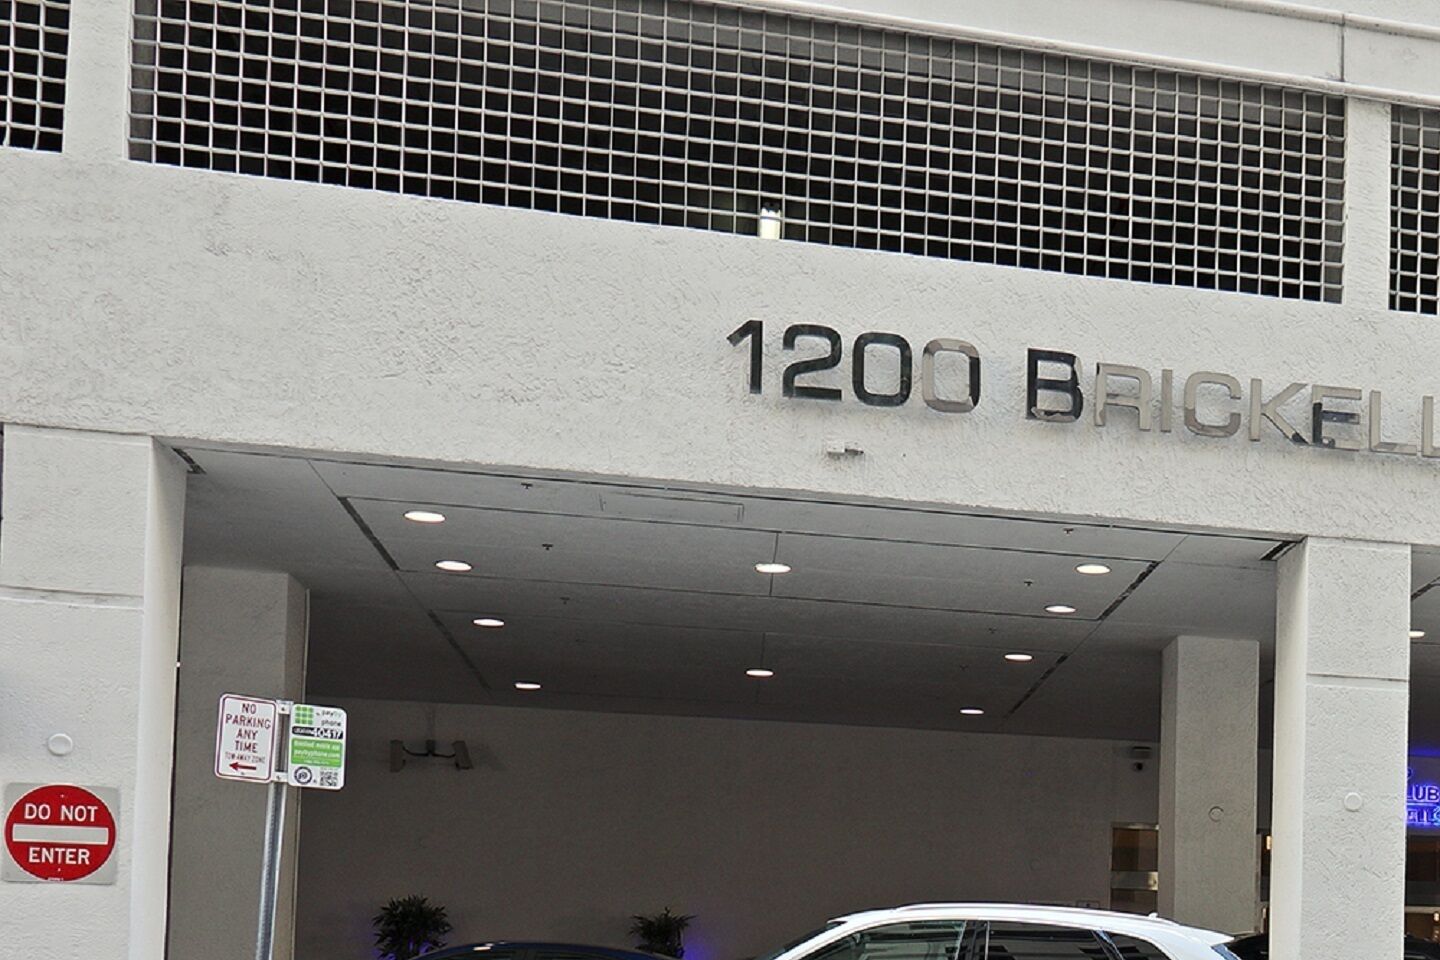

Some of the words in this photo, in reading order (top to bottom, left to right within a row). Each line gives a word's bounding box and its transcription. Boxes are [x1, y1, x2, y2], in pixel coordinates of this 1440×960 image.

[726, 319, 981, 414] 1200
[241, 703, 257, 715] NO
[225, 713, 272, 730] PARKING
[235, 728, 259, 741] ANY
[233, 740, 259, 753] TIME
[24, 803, 51, 820] DO
[60, 804, 99, 822] NOT
[28, 847, 91, 865] ENTER
